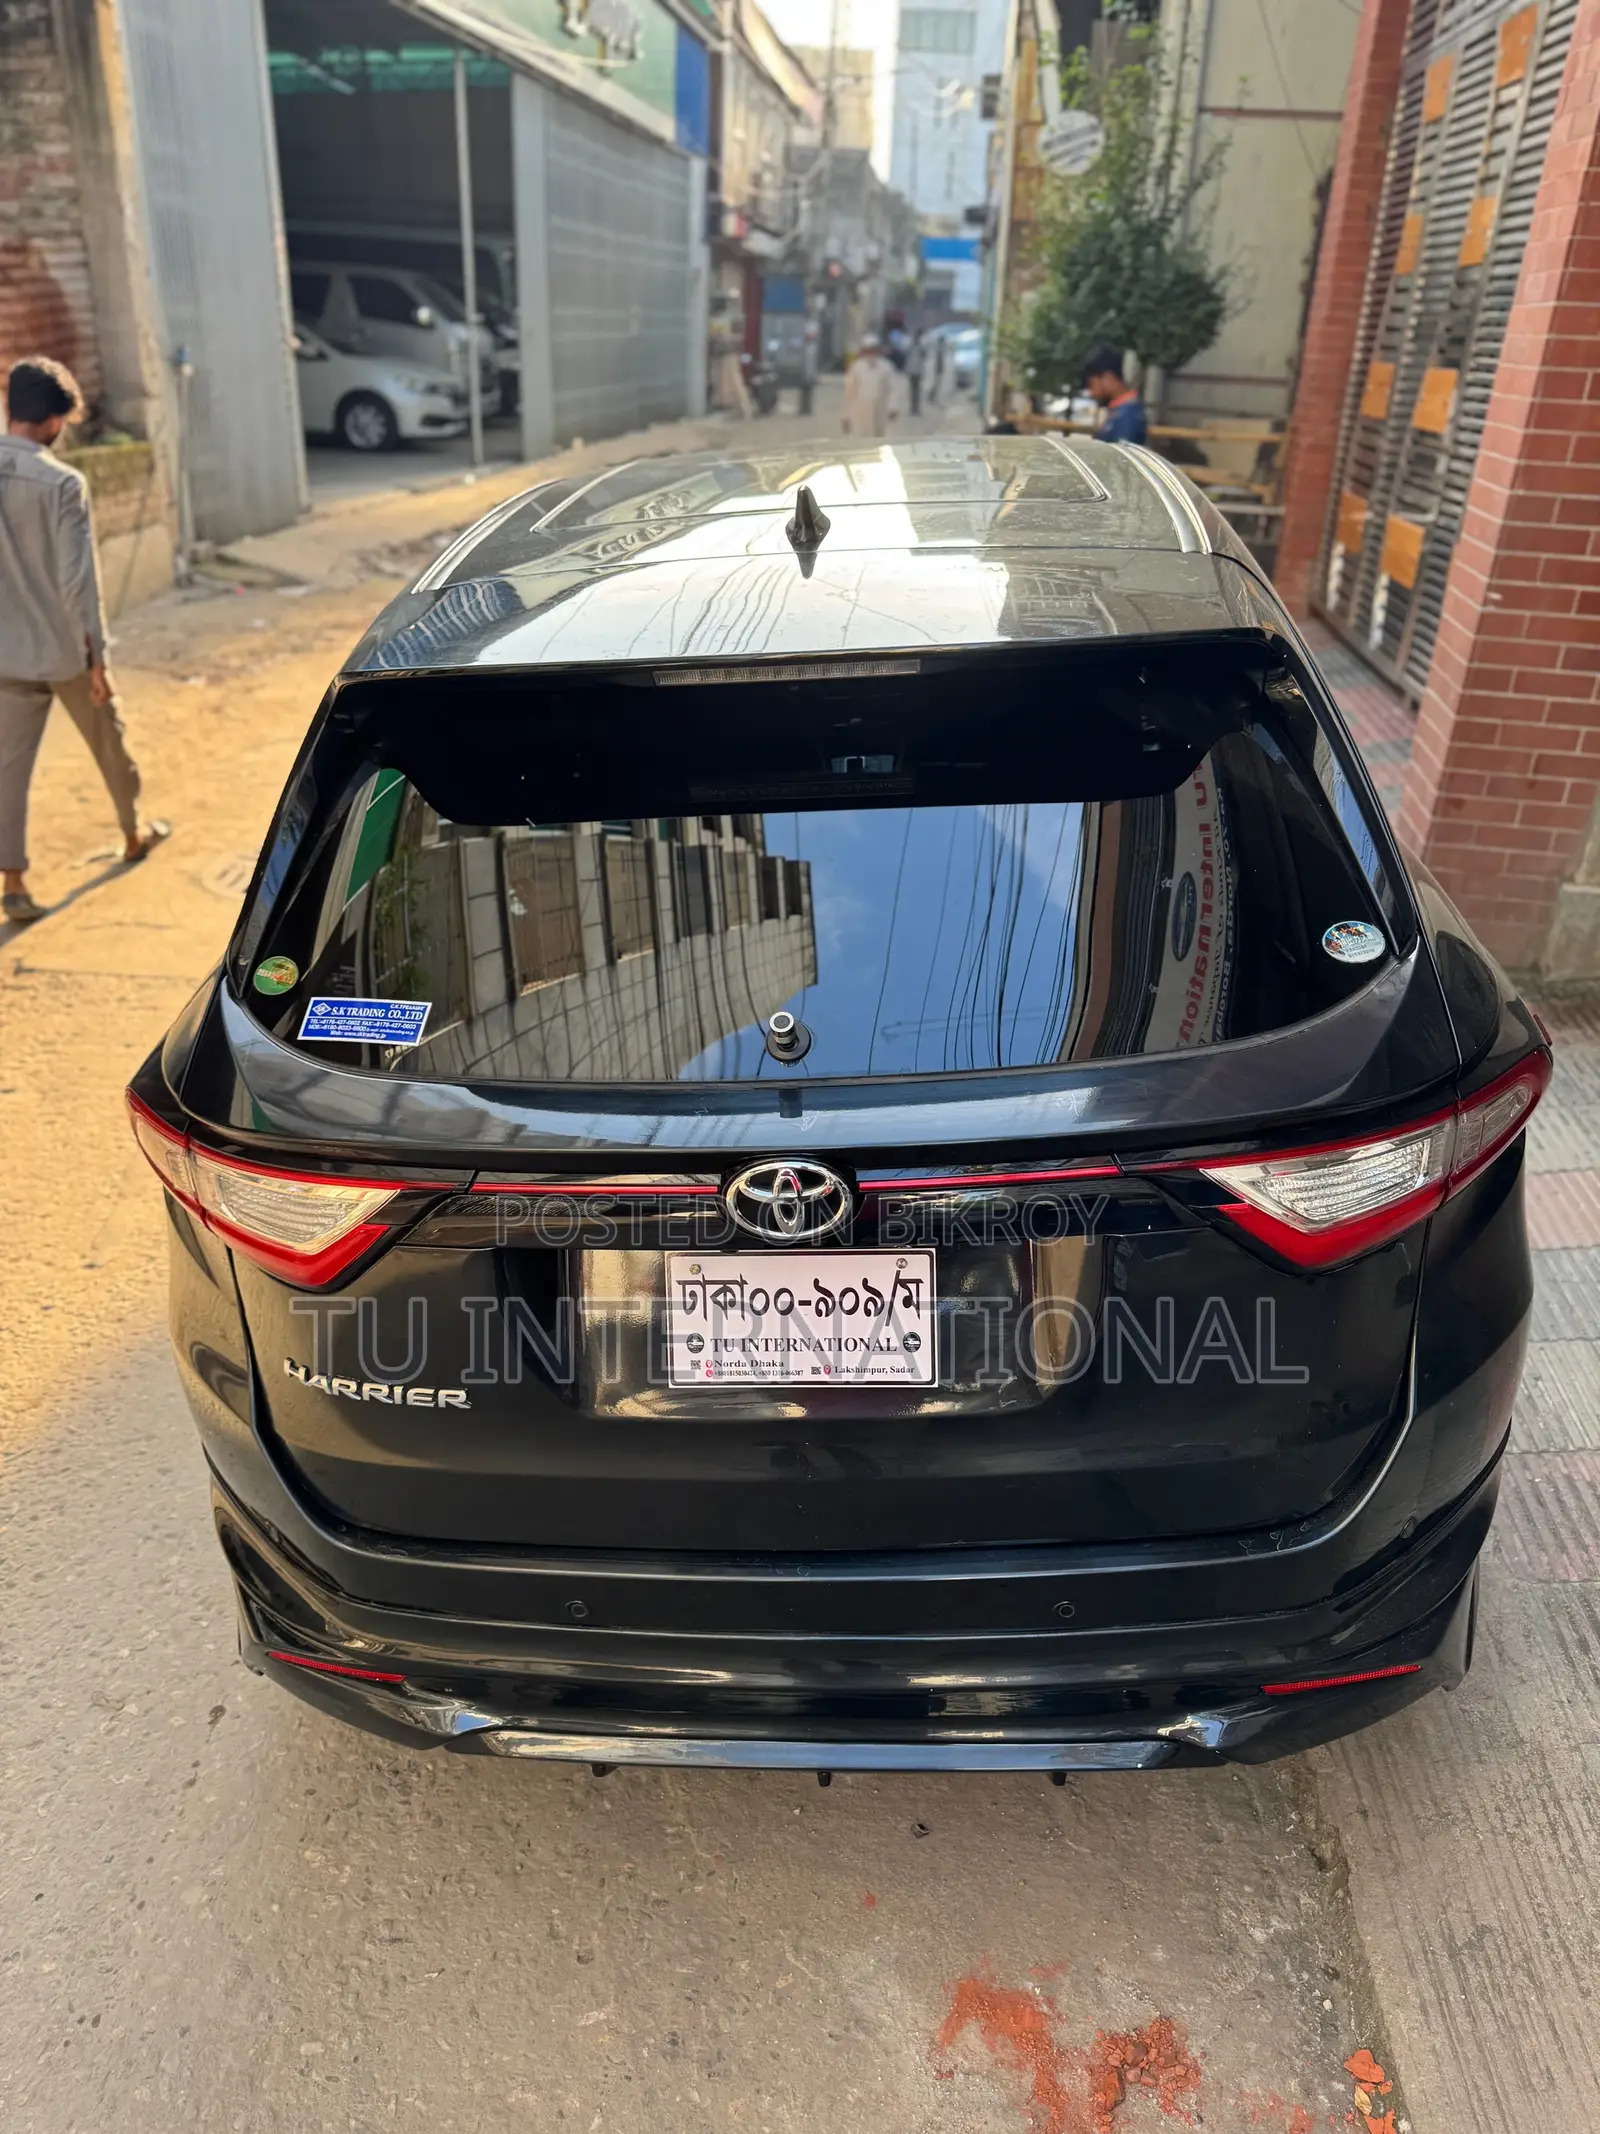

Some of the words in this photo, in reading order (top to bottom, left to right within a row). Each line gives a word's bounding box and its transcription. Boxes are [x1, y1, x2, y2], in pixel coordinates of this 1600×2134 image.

[347, 1007, 385, 1018] TRADING
[710, 1338, 736, 1353] TU
[739, 1337, 898, 1353] INTERNATIONAL
[713, 1359, 748, 1368] Norda
[749, 1359, 785, 1368] Dhaka
[834, 1365, 888, 1376] Lakshimpur,
[889, 1366, 916, 1375] Sadar
[283, 1356, 473, 1410] HARRIER
